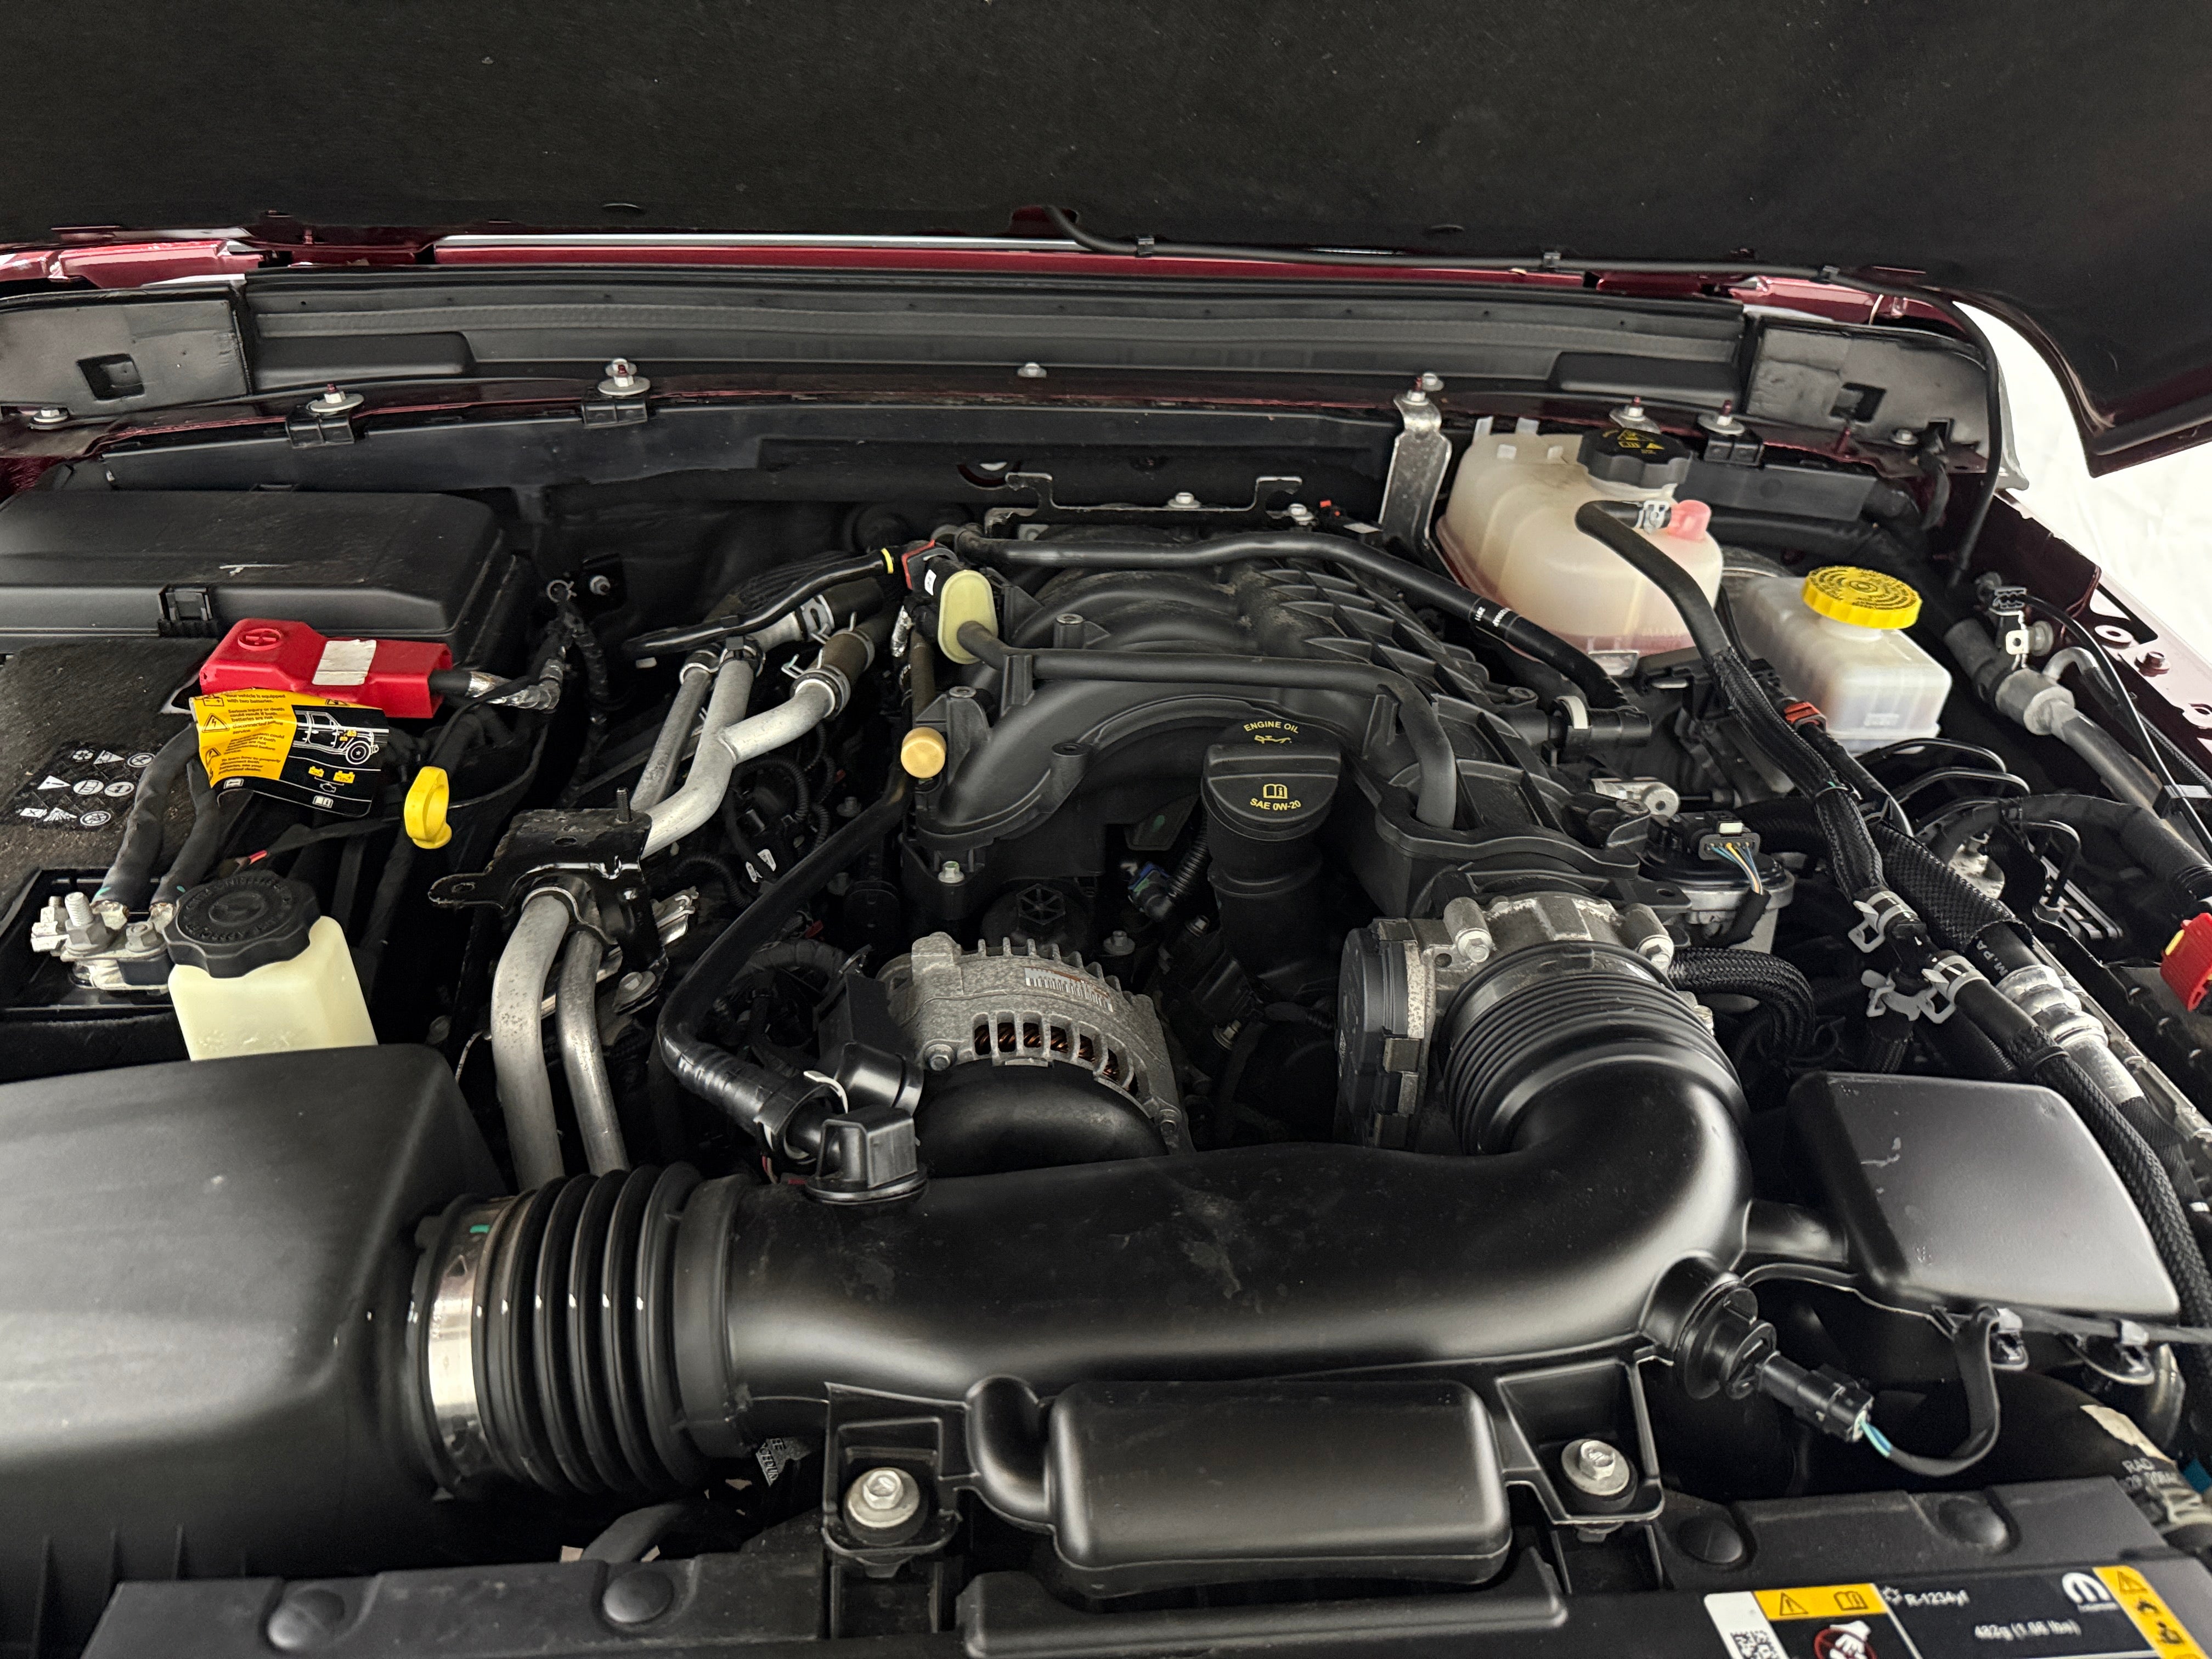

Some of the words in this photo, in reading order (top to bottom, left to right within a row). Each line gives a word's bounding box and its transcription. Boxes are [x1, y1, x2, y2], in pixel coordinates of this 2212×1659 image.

[1243, 721, 1282, 732] ENGINE
[1284, 723, 1299, 733] OIL
[1250, 798, 1271, 810] SAE
[1273, 800, 1301, 811] 0W-20
[2121, 1458, 2155, 1474] RAD
[1904, 1589, 1970, 1607] R-1234yf
